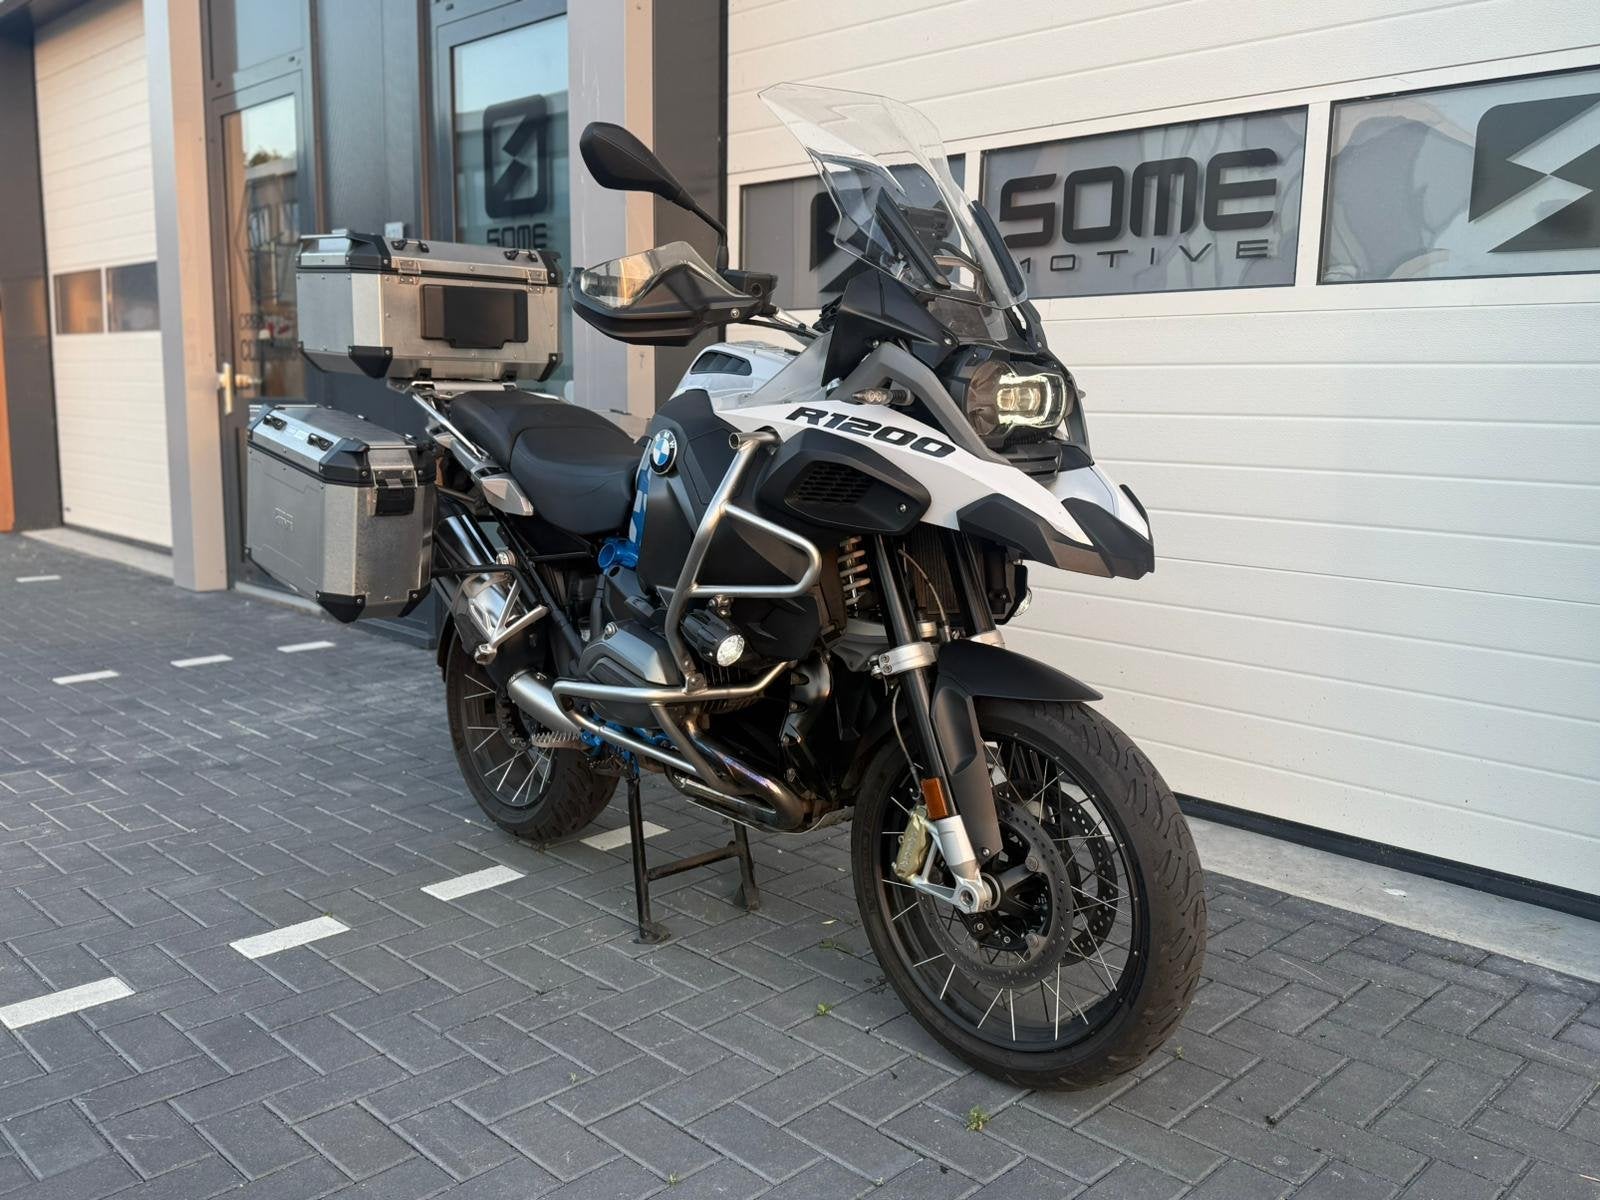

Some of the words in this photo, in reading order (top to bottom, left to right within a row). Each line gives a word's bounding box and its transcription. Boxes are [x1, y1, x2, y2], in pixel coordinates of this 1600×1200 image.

[1000, 148, 1278, 248] SOME
[487, 223, 547, 249] SOME
[785, 406, 956, 458] R1200
